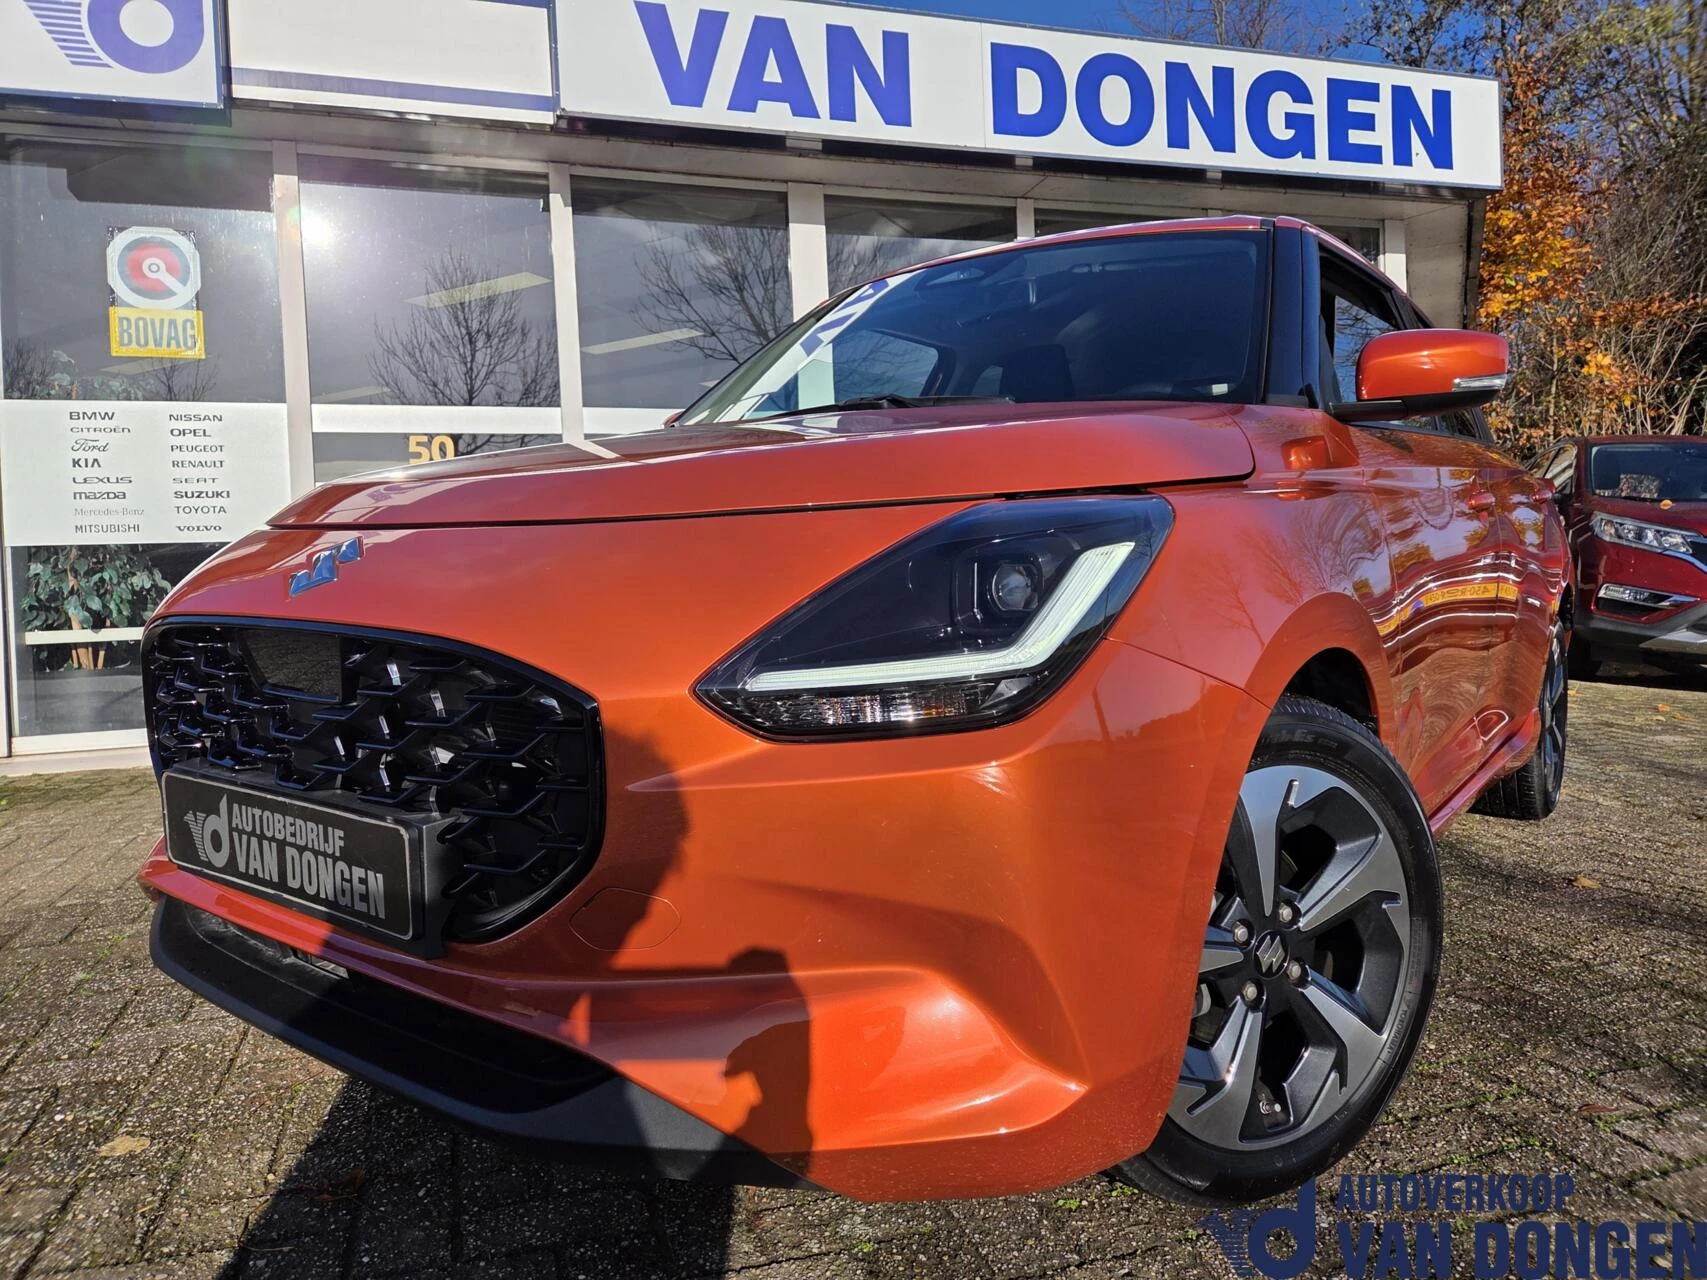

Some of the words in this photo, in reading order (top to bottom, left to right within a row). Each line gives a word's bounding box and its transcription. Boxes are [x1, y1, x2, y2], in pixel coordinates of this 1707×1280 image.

[634, 0, 912, 128] VAN
[990, 42, 1454, 170] DONGEN
[118, 316, 197, 350] BOVAG
[69, 411, 115, 421] BMW
[169, 414, 223, 422] NISSAN
[170, 428, 212, 437] OPEL
[71, 438, 110, 453] Ford
[170, 444, 224, 453] PEUGEOT
[408, 435, 455, 465] 50
[72, 458, 102, 468] KIA
[171, 460, 225, 469] RENAULT
[72, 476, 133, 485] LEXUS
[174, 490, 230, 499] SUZUKI
[74, 507, 145, 517] Mercedes-Benz
[174, 505, 227, 515] TOYOTA
[75, 523, 140, 534] MITSUBISHI
[232, 803, 345, 857] AUTOBEDRIJF
[232, 831, 279, 883] VAN
[285, 847, 386, 920] DONGEN
